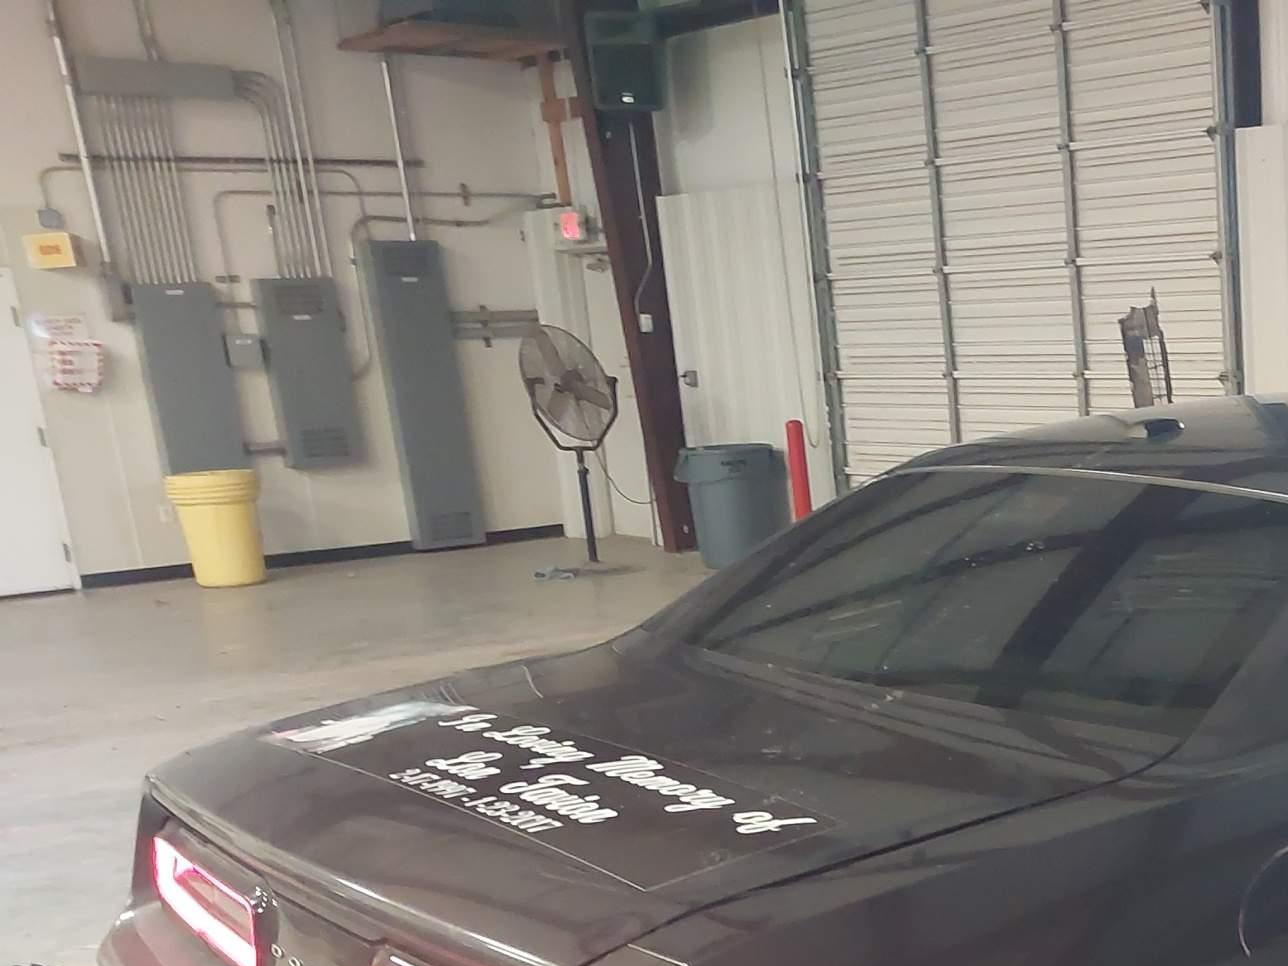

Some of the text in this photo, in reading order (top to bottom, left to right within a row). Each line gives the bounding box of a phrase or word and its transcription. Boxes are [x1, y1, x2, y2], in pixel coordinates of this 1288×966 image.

[425, 751, 503, 780] Lon
[438, 713, 817, 834] In Loving Memory of
